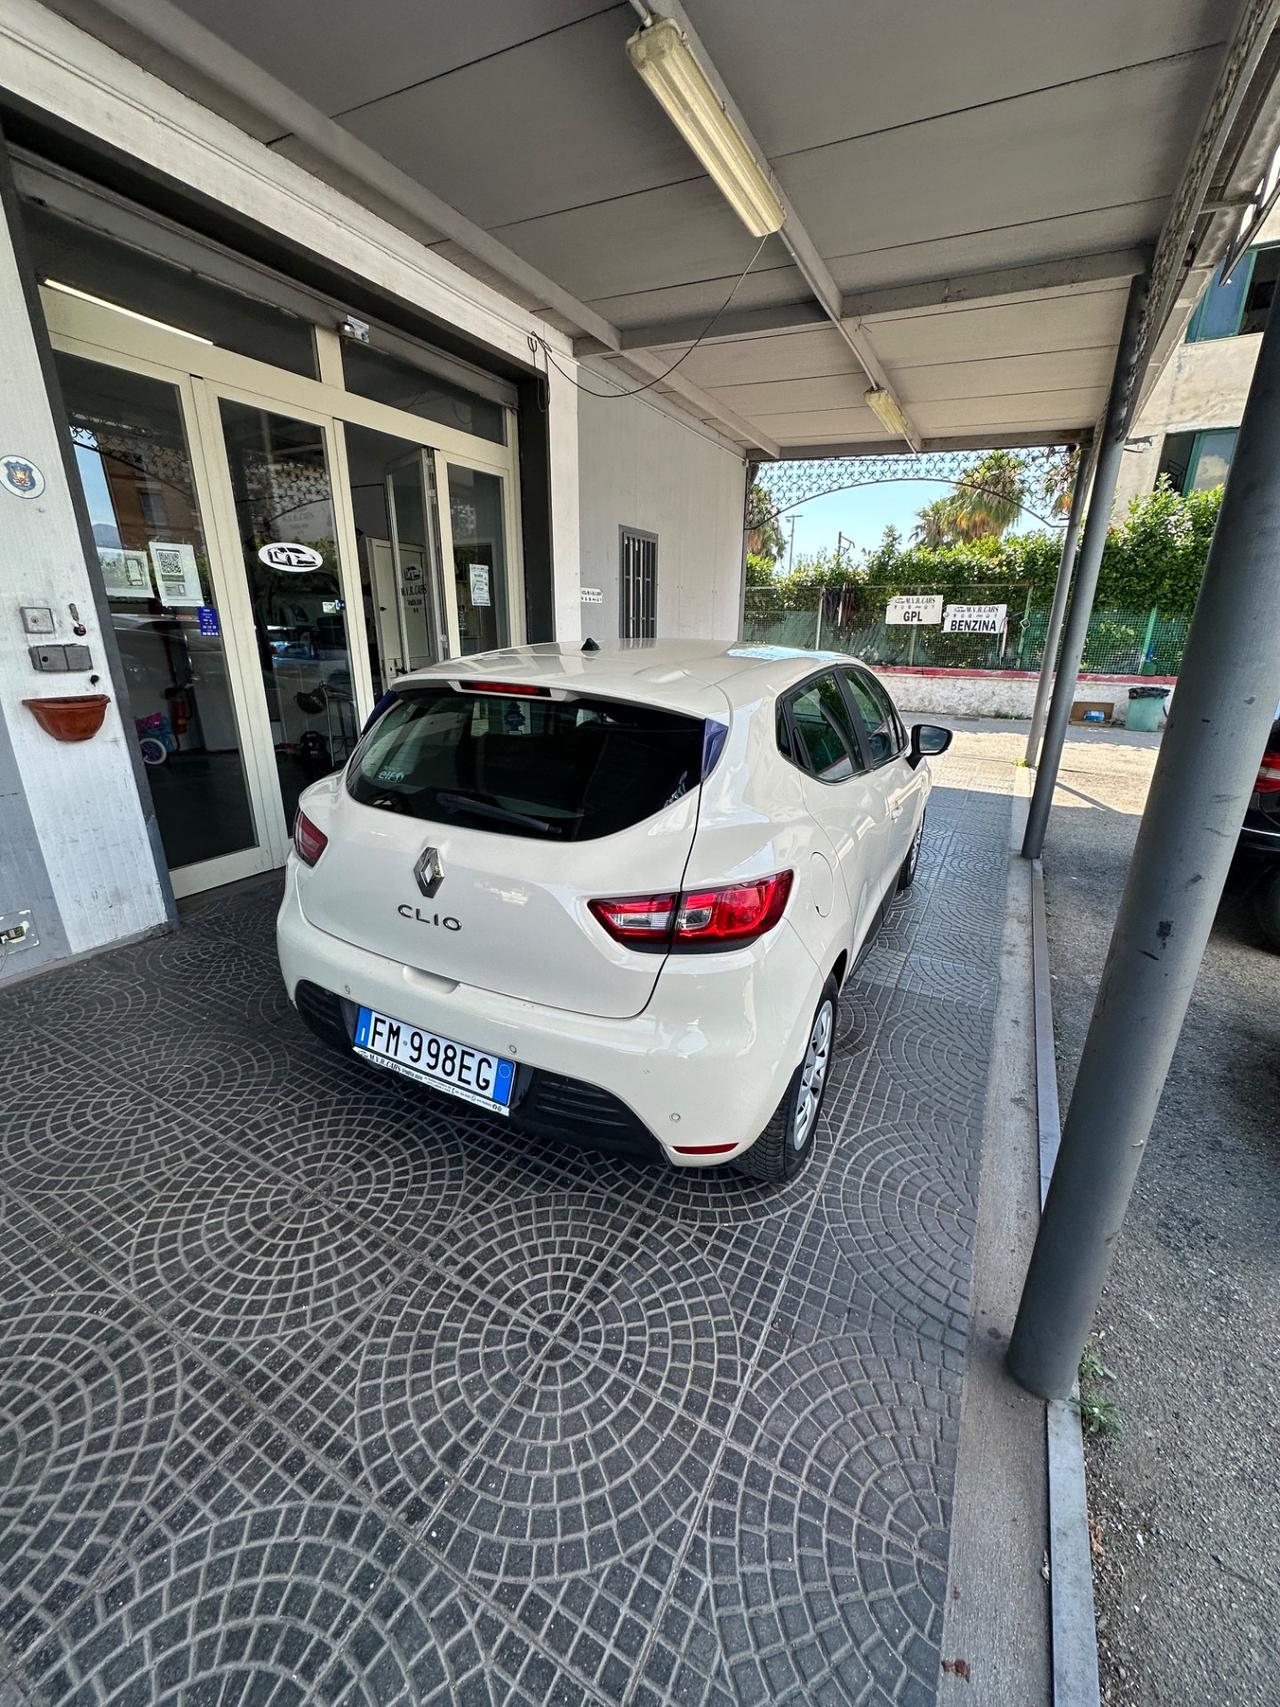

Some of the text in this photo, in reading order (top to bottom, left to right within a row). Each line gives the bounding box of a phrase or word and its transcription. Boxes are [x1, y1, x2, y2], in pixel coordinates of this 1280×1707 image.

[903, 611, 923, 622] GPL
[950, 620, 997, 631] BENZINA
[398, 904, 463, 932] CLIO
[371, 1017, 493, 1091] FM 998EG
